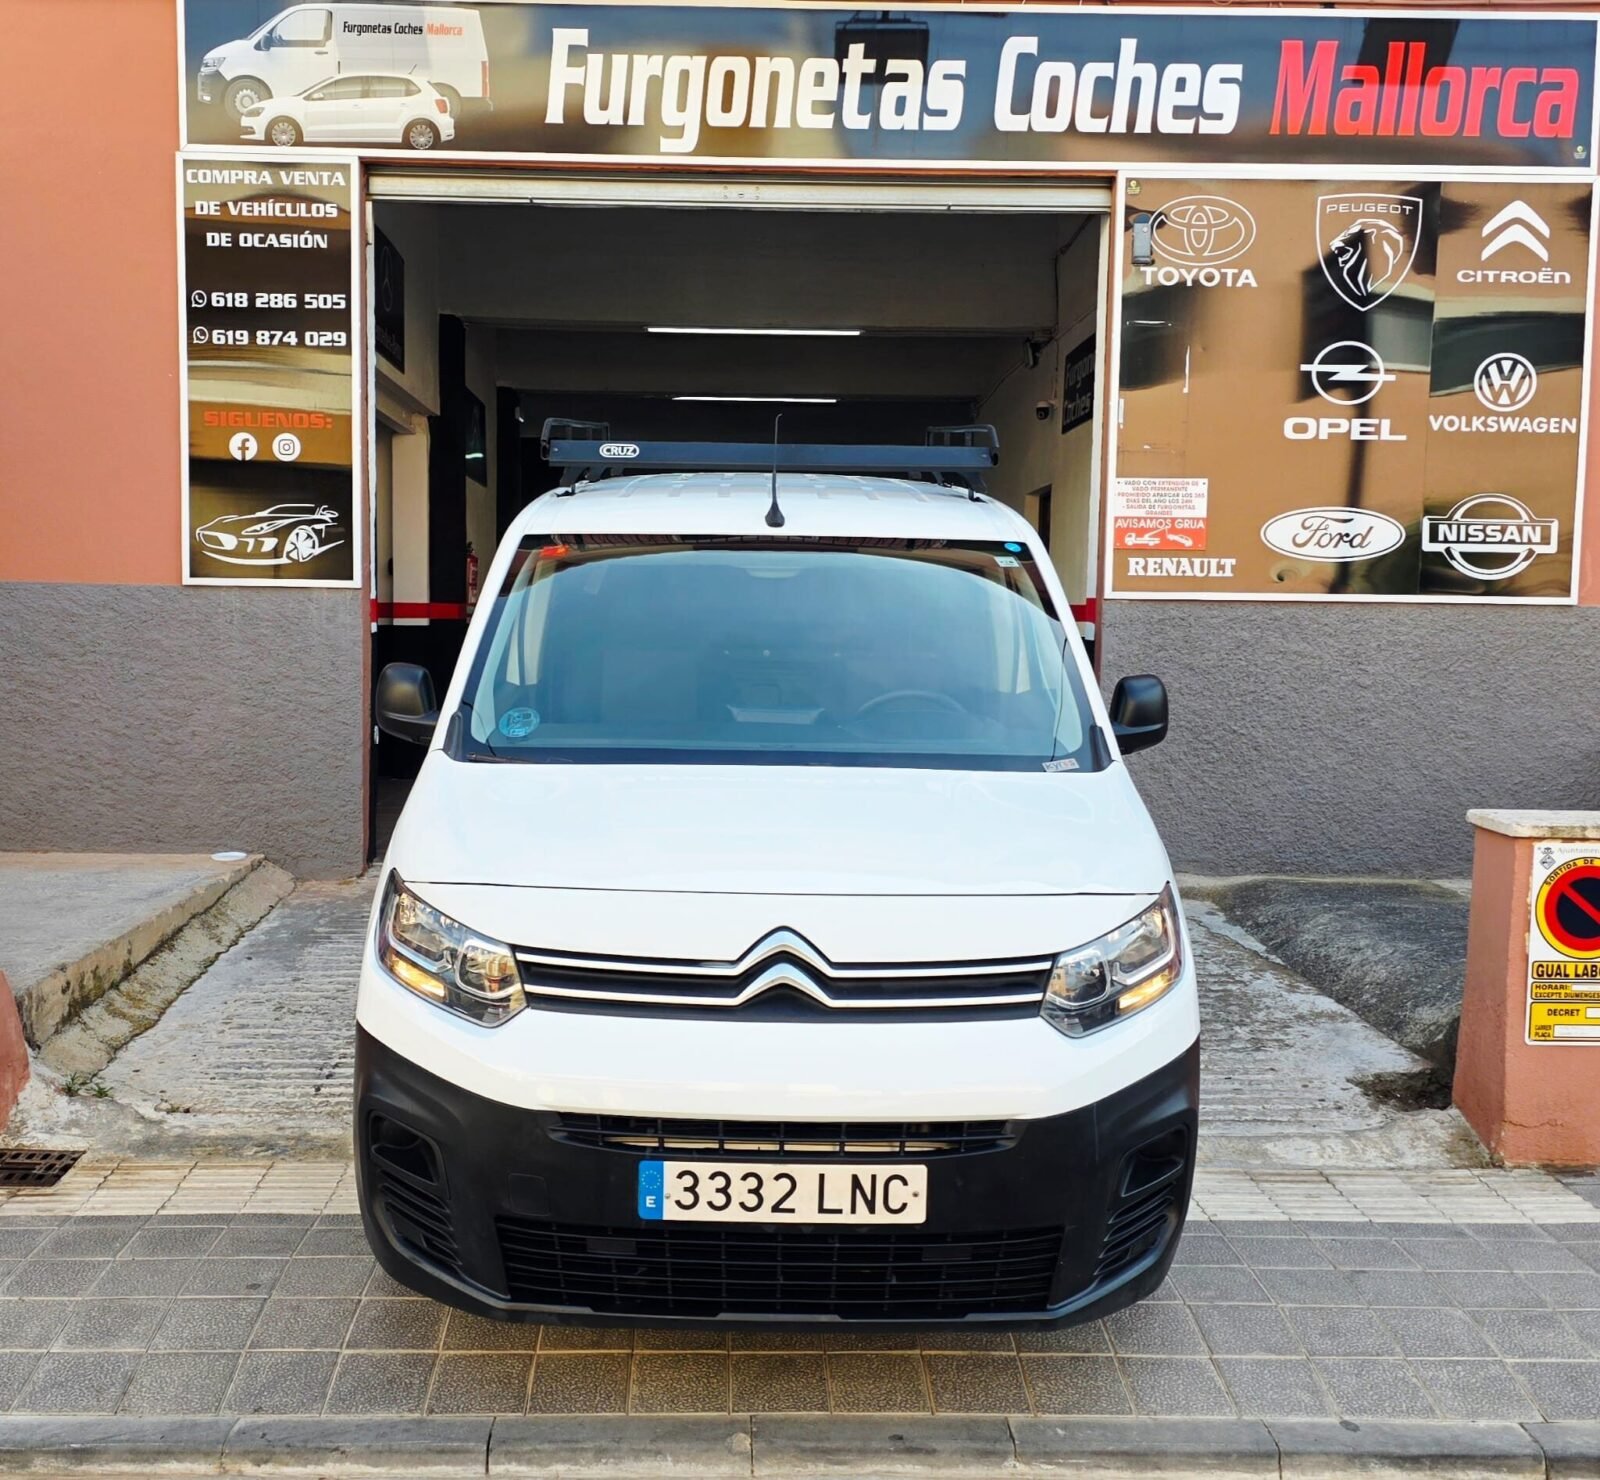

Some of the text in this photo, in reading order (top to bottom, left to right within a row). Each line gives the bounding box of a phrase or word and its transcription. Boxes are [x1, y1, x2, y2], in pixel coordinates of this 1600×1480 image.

[343, 21, 463, 36] Furgonetas Coches Mallorca
[544, 28, 1580, 153] Furgonetas Coches Mallorca
[186, 169, 346, 186] COMPRA VENTA
[195, 199, 338, 218] DE VEHÍCULOS
[1326, 203, 1413, 216] PEUGEOT
[206, 231, 328, 249] DE OCASIÓN
[1140, 266, 1258, 287] TOYOTA
[211, 292, 346, 309] 618 286 505
[212, 329, 347, 347] 619 874 029
[203, 411, 333, 429] SIGUENOS:
[1283, 417, 1407, 441] OPEL
[1429, 415, 1577, 434] VOLKSWAGEN
[602, 445, 635, 456] CRUZ
[1115, 519, 1205, 529] AVISAMOS GRUA
[1292, 515, 1374, 549] Ford
[1438, 524, 1542, 544] NISSAN
[1127, 557, 1236, 577] RENAULT
[1545, 862, 1578, 886] SORTIDA
[1536, 964, 1600, 978] GUAL LAB
[1547, 1008, 1580, 1016] DECRET
[645, 1170, 909, 1215] E 3332 LNC
